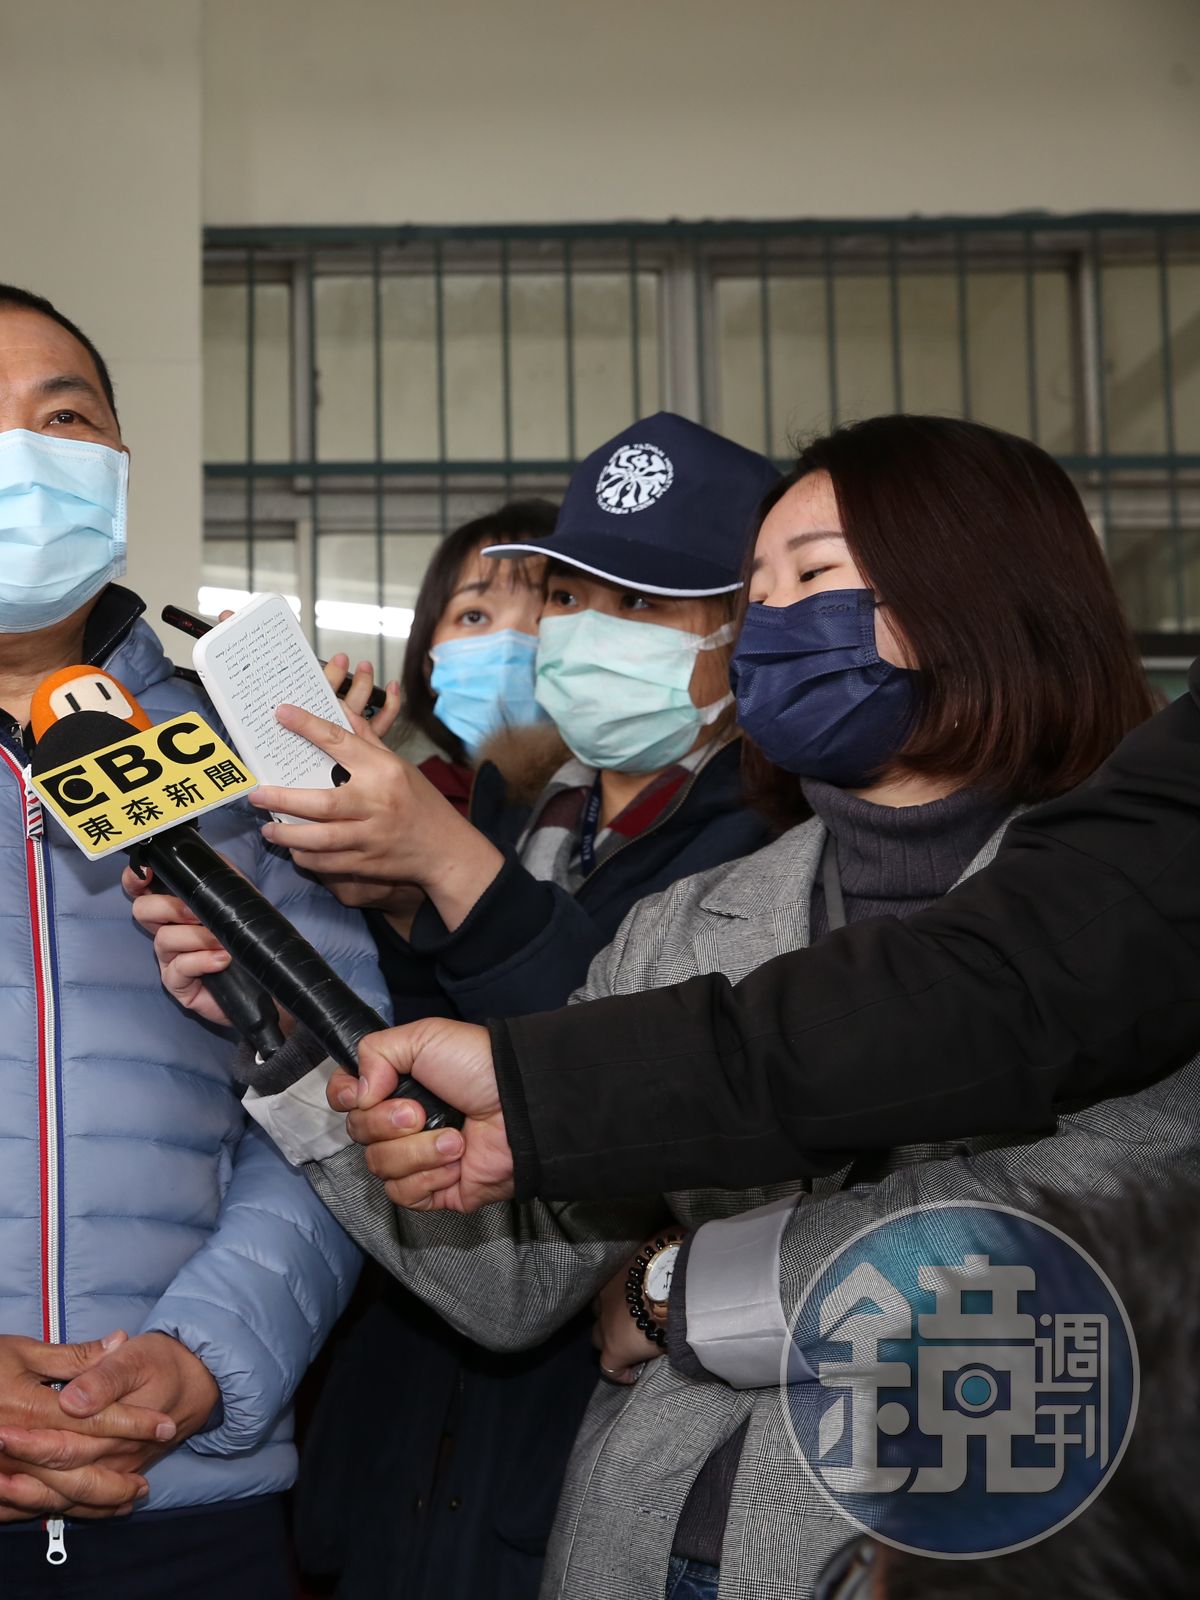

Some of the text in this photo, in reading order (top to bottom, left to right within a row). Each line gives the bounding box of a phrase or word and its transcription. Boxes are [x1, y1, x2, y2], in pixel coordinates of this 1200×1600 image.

[40, 722, 216, 817] EBC
[78, 759, 248, 846] 東森新聞
